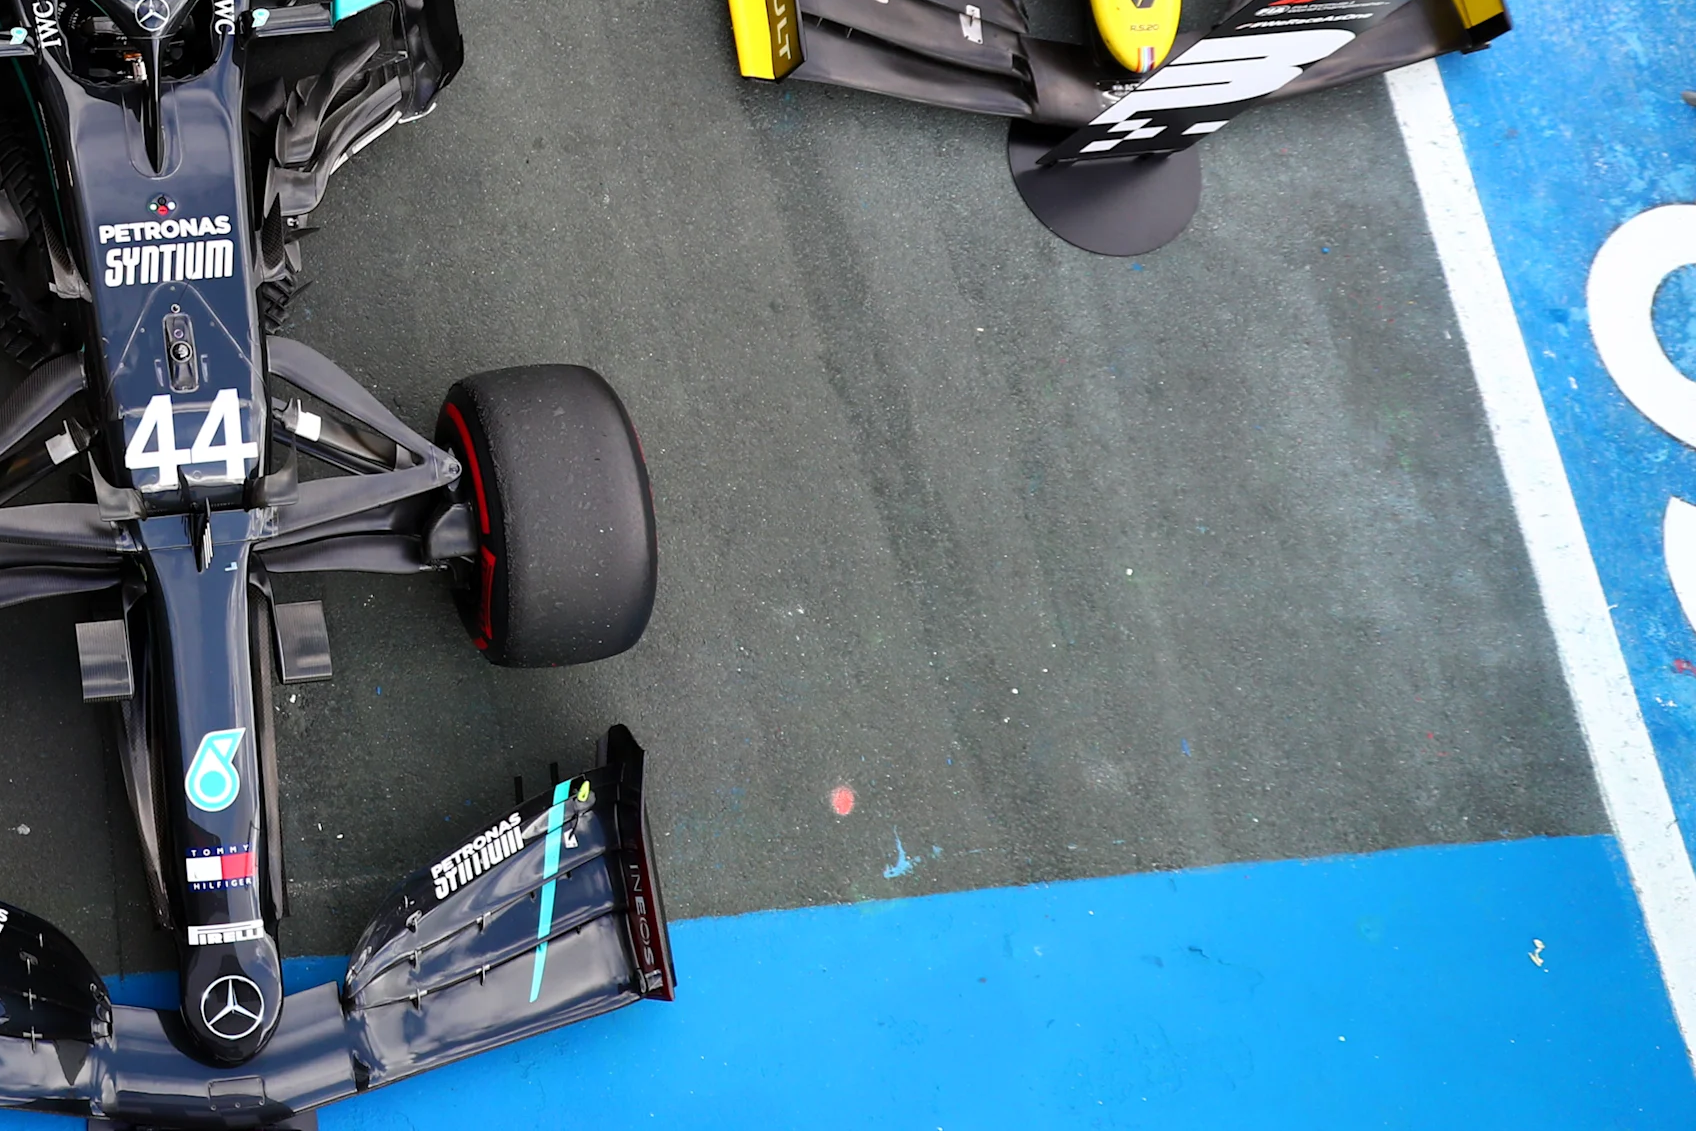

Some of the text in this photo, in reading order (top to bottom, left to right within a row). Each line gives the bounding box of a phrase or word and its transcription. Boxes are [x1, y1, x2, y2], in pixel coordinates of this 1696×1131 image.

[32, 0, 62, 49] IWC
[99, 215, 232, 244] PETRONAS
[104, 239, 234, 288] SYNTIUM
[124, 388, 259, 489] 44
[191, 844, 250, 858] TOMMY
[431, 812, 522, 881] PETRONAS
[193, 878, 252, 891] HILFIGER
[188, 919, 264, 946] PIRELLI
[630, 864, 654, 966] INEOS
